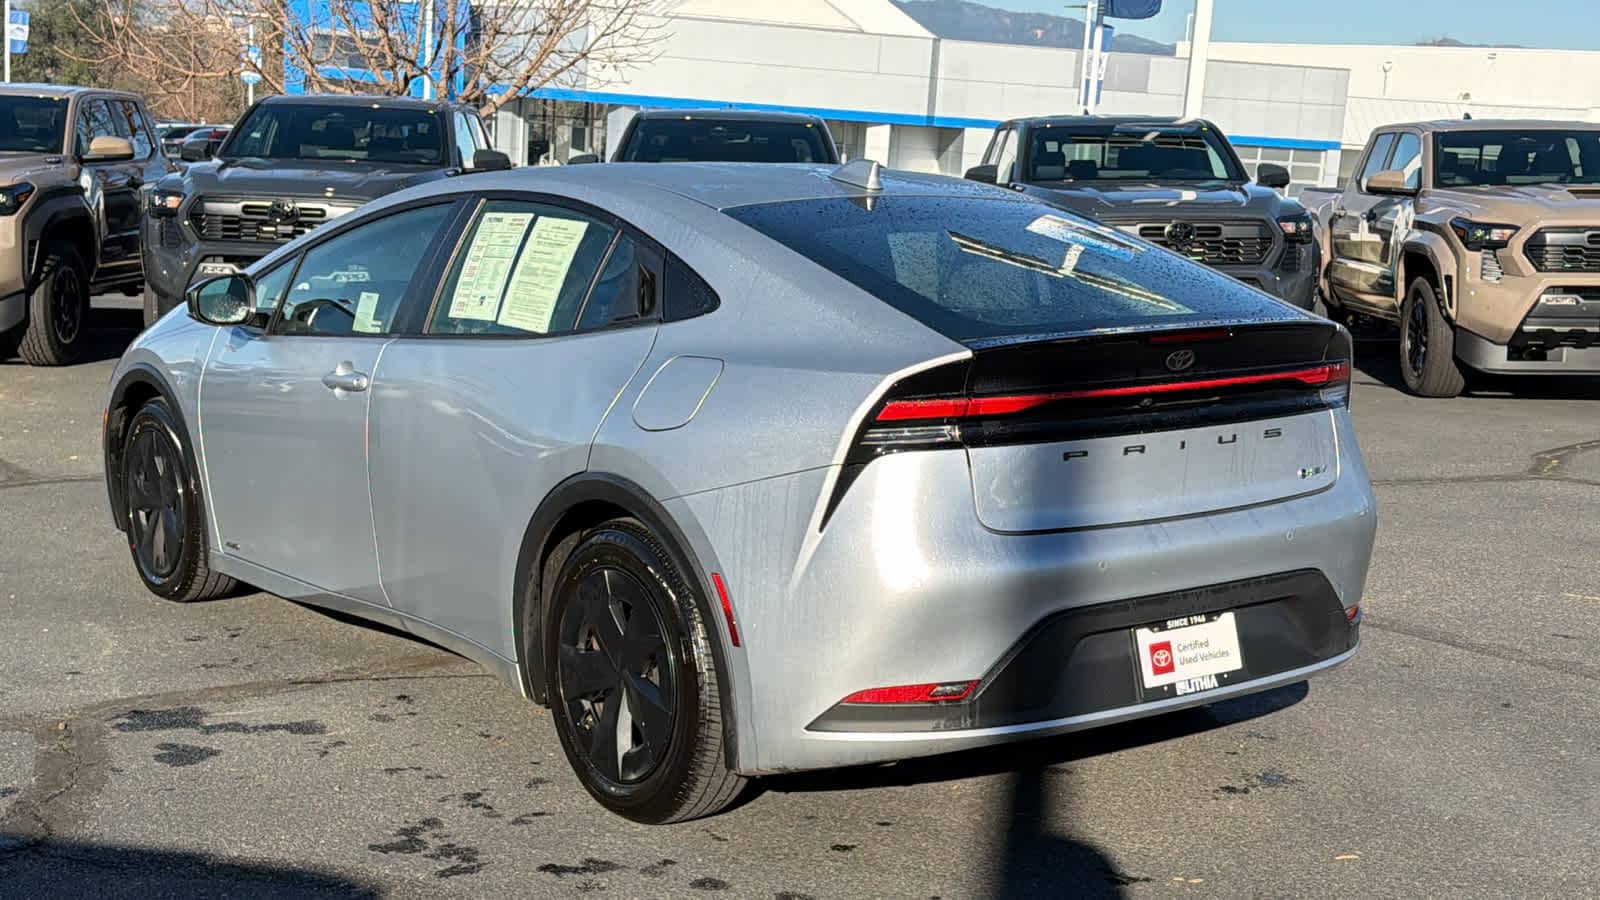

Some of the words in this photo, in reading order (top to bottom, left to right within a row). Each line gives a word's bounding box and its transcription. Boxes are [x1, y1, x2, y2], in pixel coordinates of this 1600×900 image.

[1063, 428, 1282, 461] PRIUS
[1166, 617, 1189, 629] SINCE
[1177, 639, 1209, 652] Certified
[1179, 655, 1198, 665] Used
[1199, 648, 1230, 662] Vehicles
[1185, 674, 1219, 693] LITHIA
